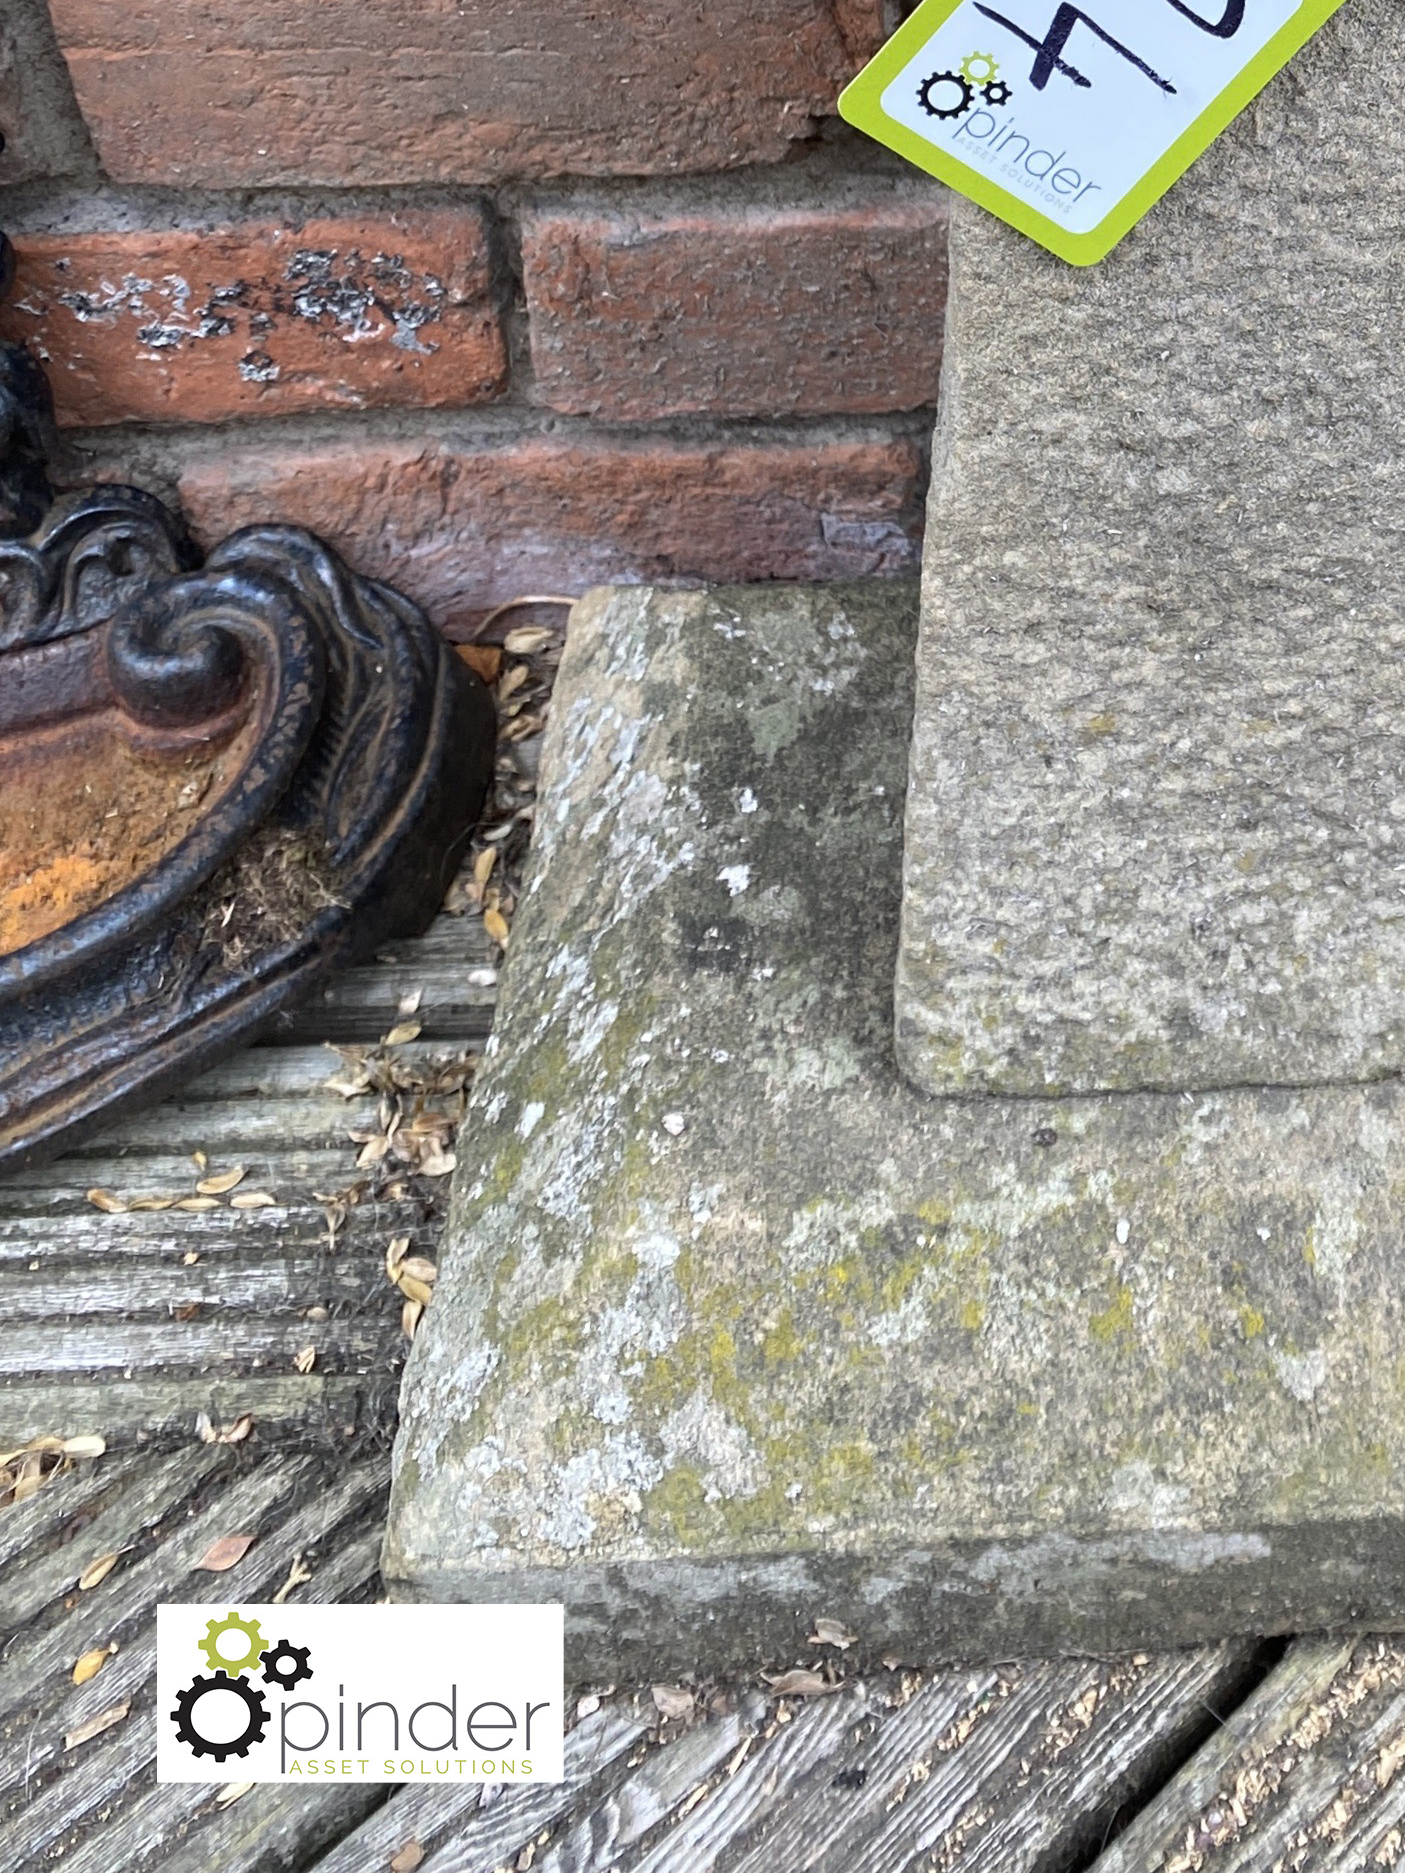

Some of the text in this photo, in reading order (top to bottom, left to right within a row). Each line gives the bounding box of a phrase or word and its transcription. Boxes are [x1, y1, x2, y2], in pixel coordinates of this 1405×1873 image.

[952, 107, 1102, 204] pinder
[955, 136, 1074, 215] ASSET SOLUTIONS
